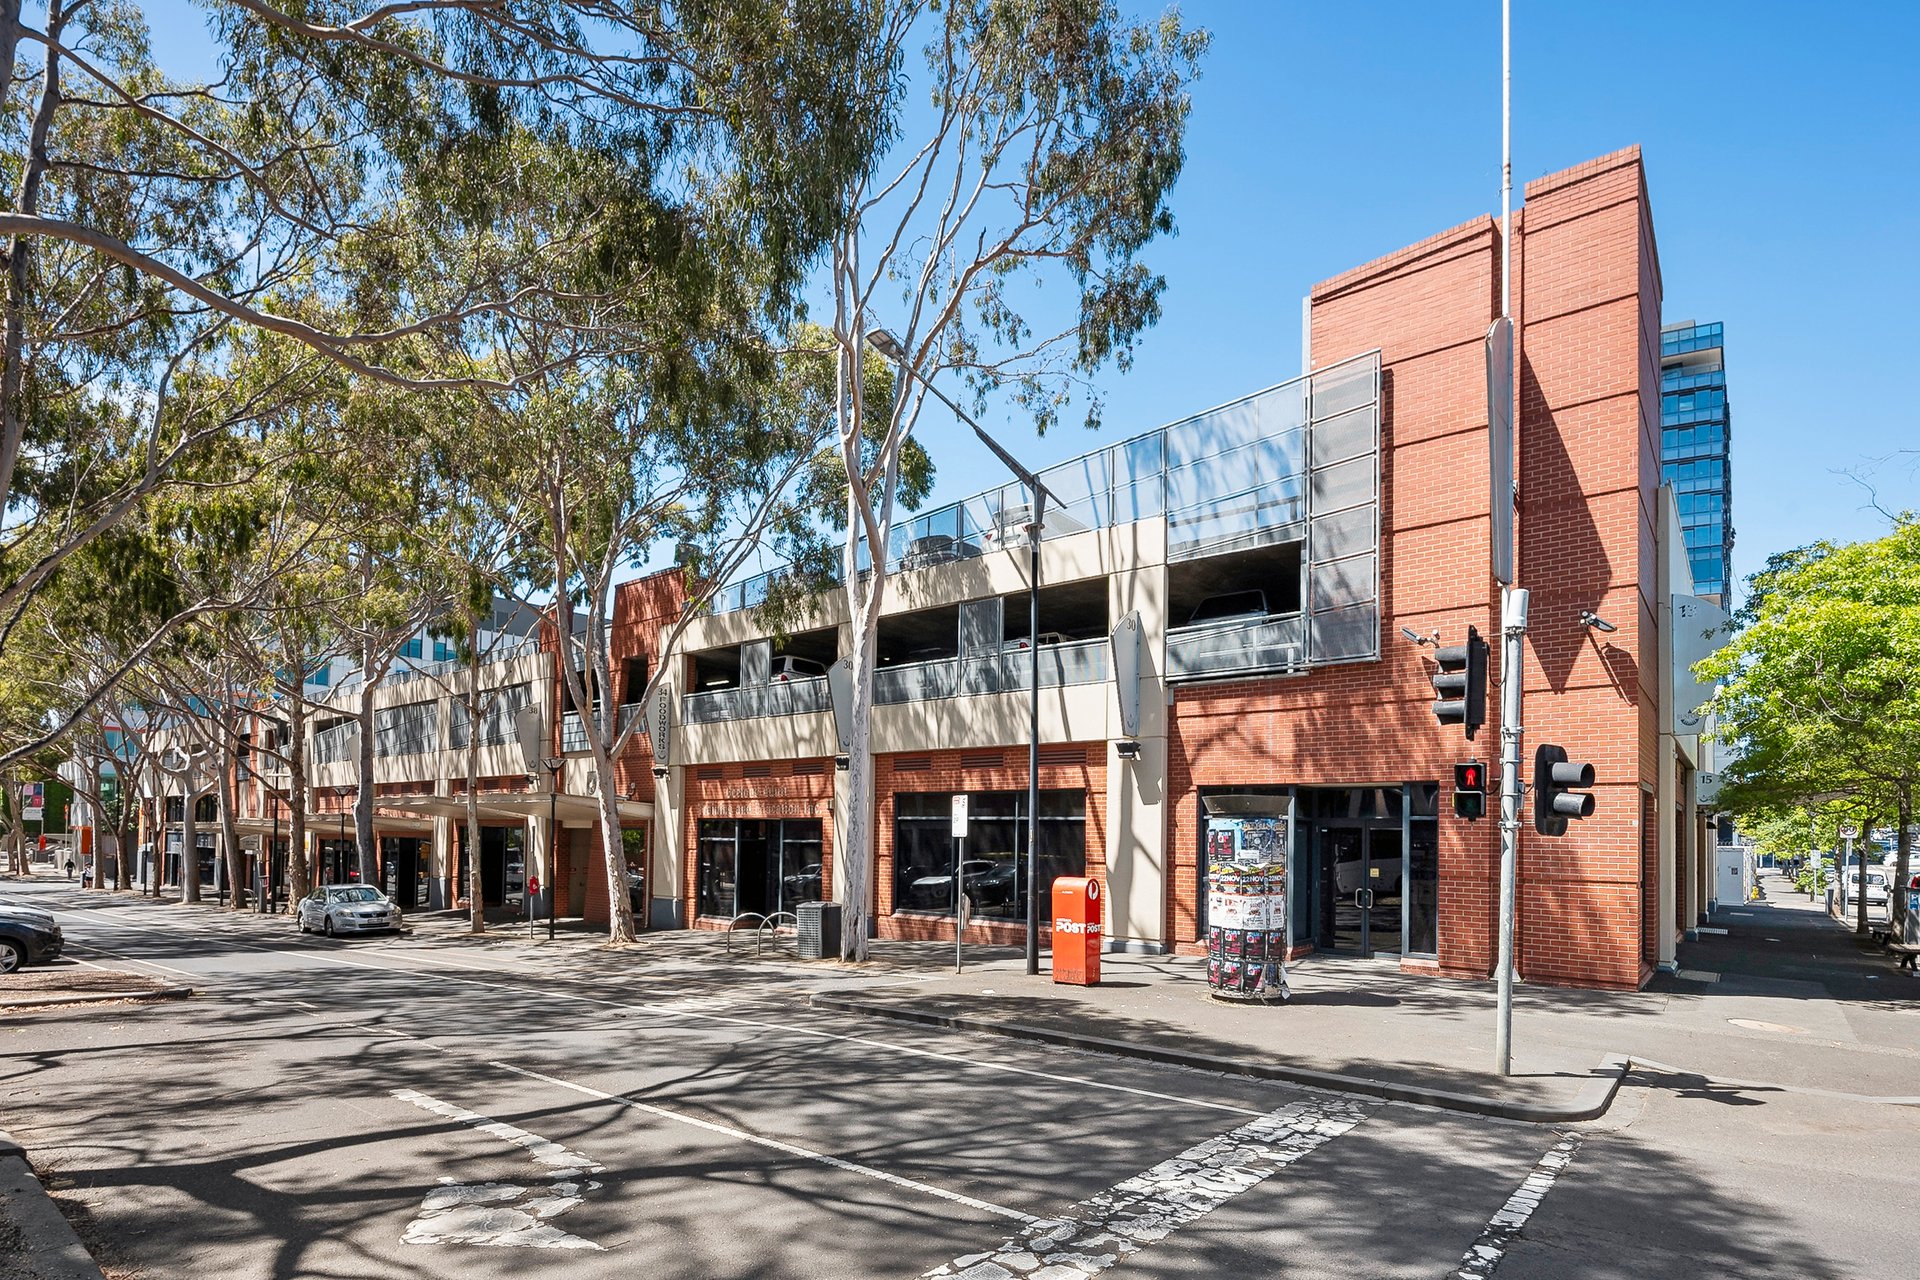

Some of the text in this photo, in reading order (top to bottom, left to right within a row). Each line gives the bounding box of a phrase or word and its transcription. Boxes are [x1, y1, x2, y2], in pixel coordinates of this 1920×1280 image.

[1127, 618, 1136, 631] 30
[843, 659, 853, 671] 30
[658, 688, 667, 696] 34
[528, 706, 538, 715] 38
[659, 697, 667, 750] FOODWORKS
[1701, 775, 1712, 784] 15
[1056, 922, 1086, 933] POST
